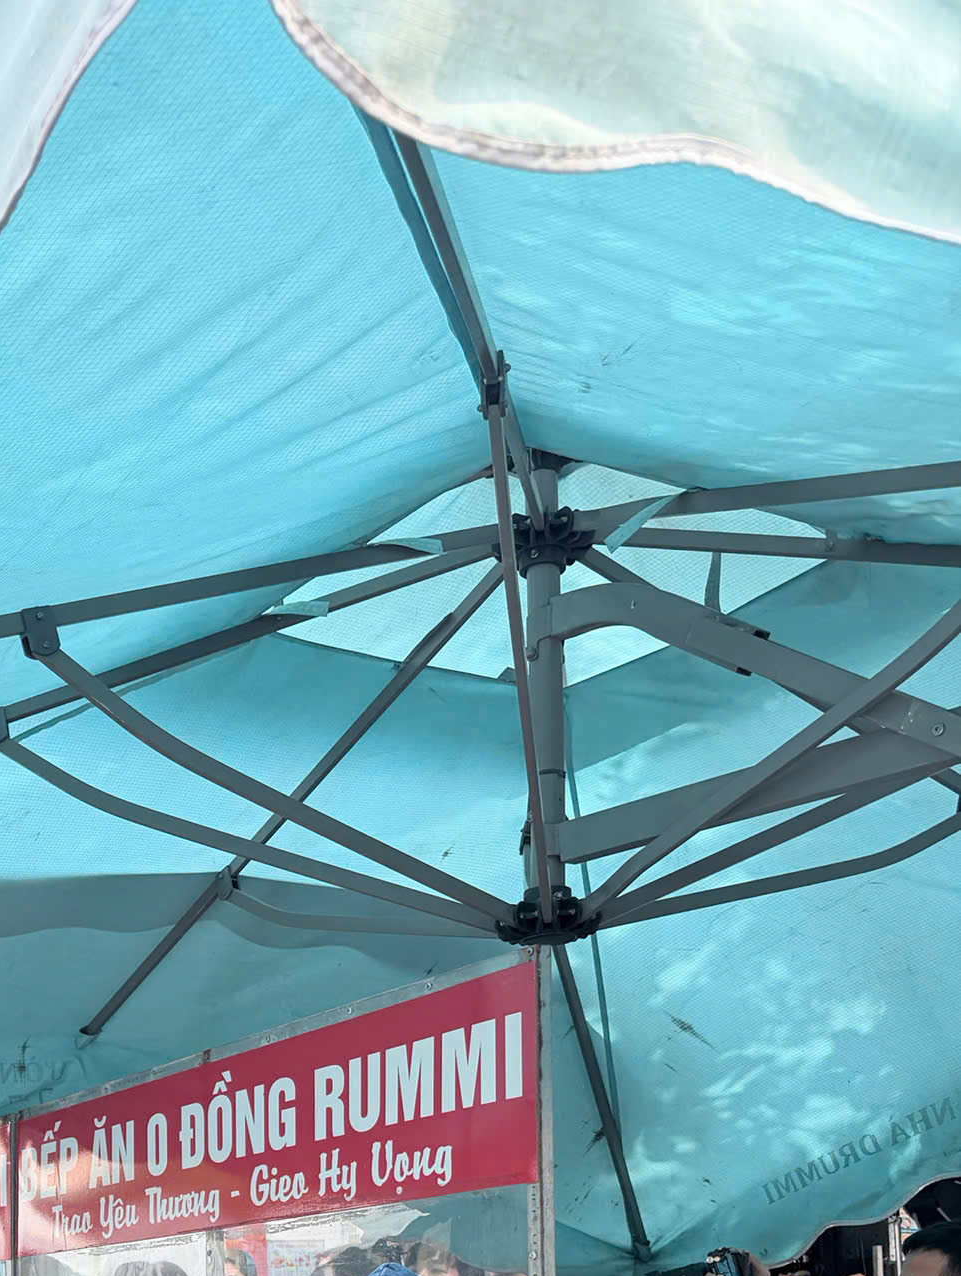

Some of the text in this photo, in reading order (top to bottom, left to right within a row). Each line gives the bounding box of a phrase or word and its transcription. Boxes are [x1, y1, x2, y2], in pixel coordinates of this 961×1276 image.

[19, 1119, 79, 1202] BẾP
[89, 1115, 136, 1190] ĂN
[178, 1069, 297, 1171] ĐỒNG
[313, 1011, 524, 1142] RUMMI
[51, 1204, 93, 1238] Trao
[99, 1194, 139, 1239] Yêu
[145, 1185, 221, 1223] Thương
[249, 1163, 309, 1207] Gieo
[317, 1147, 358, 1202] Hy
[370, 1139, 453, 1195] Vọng
